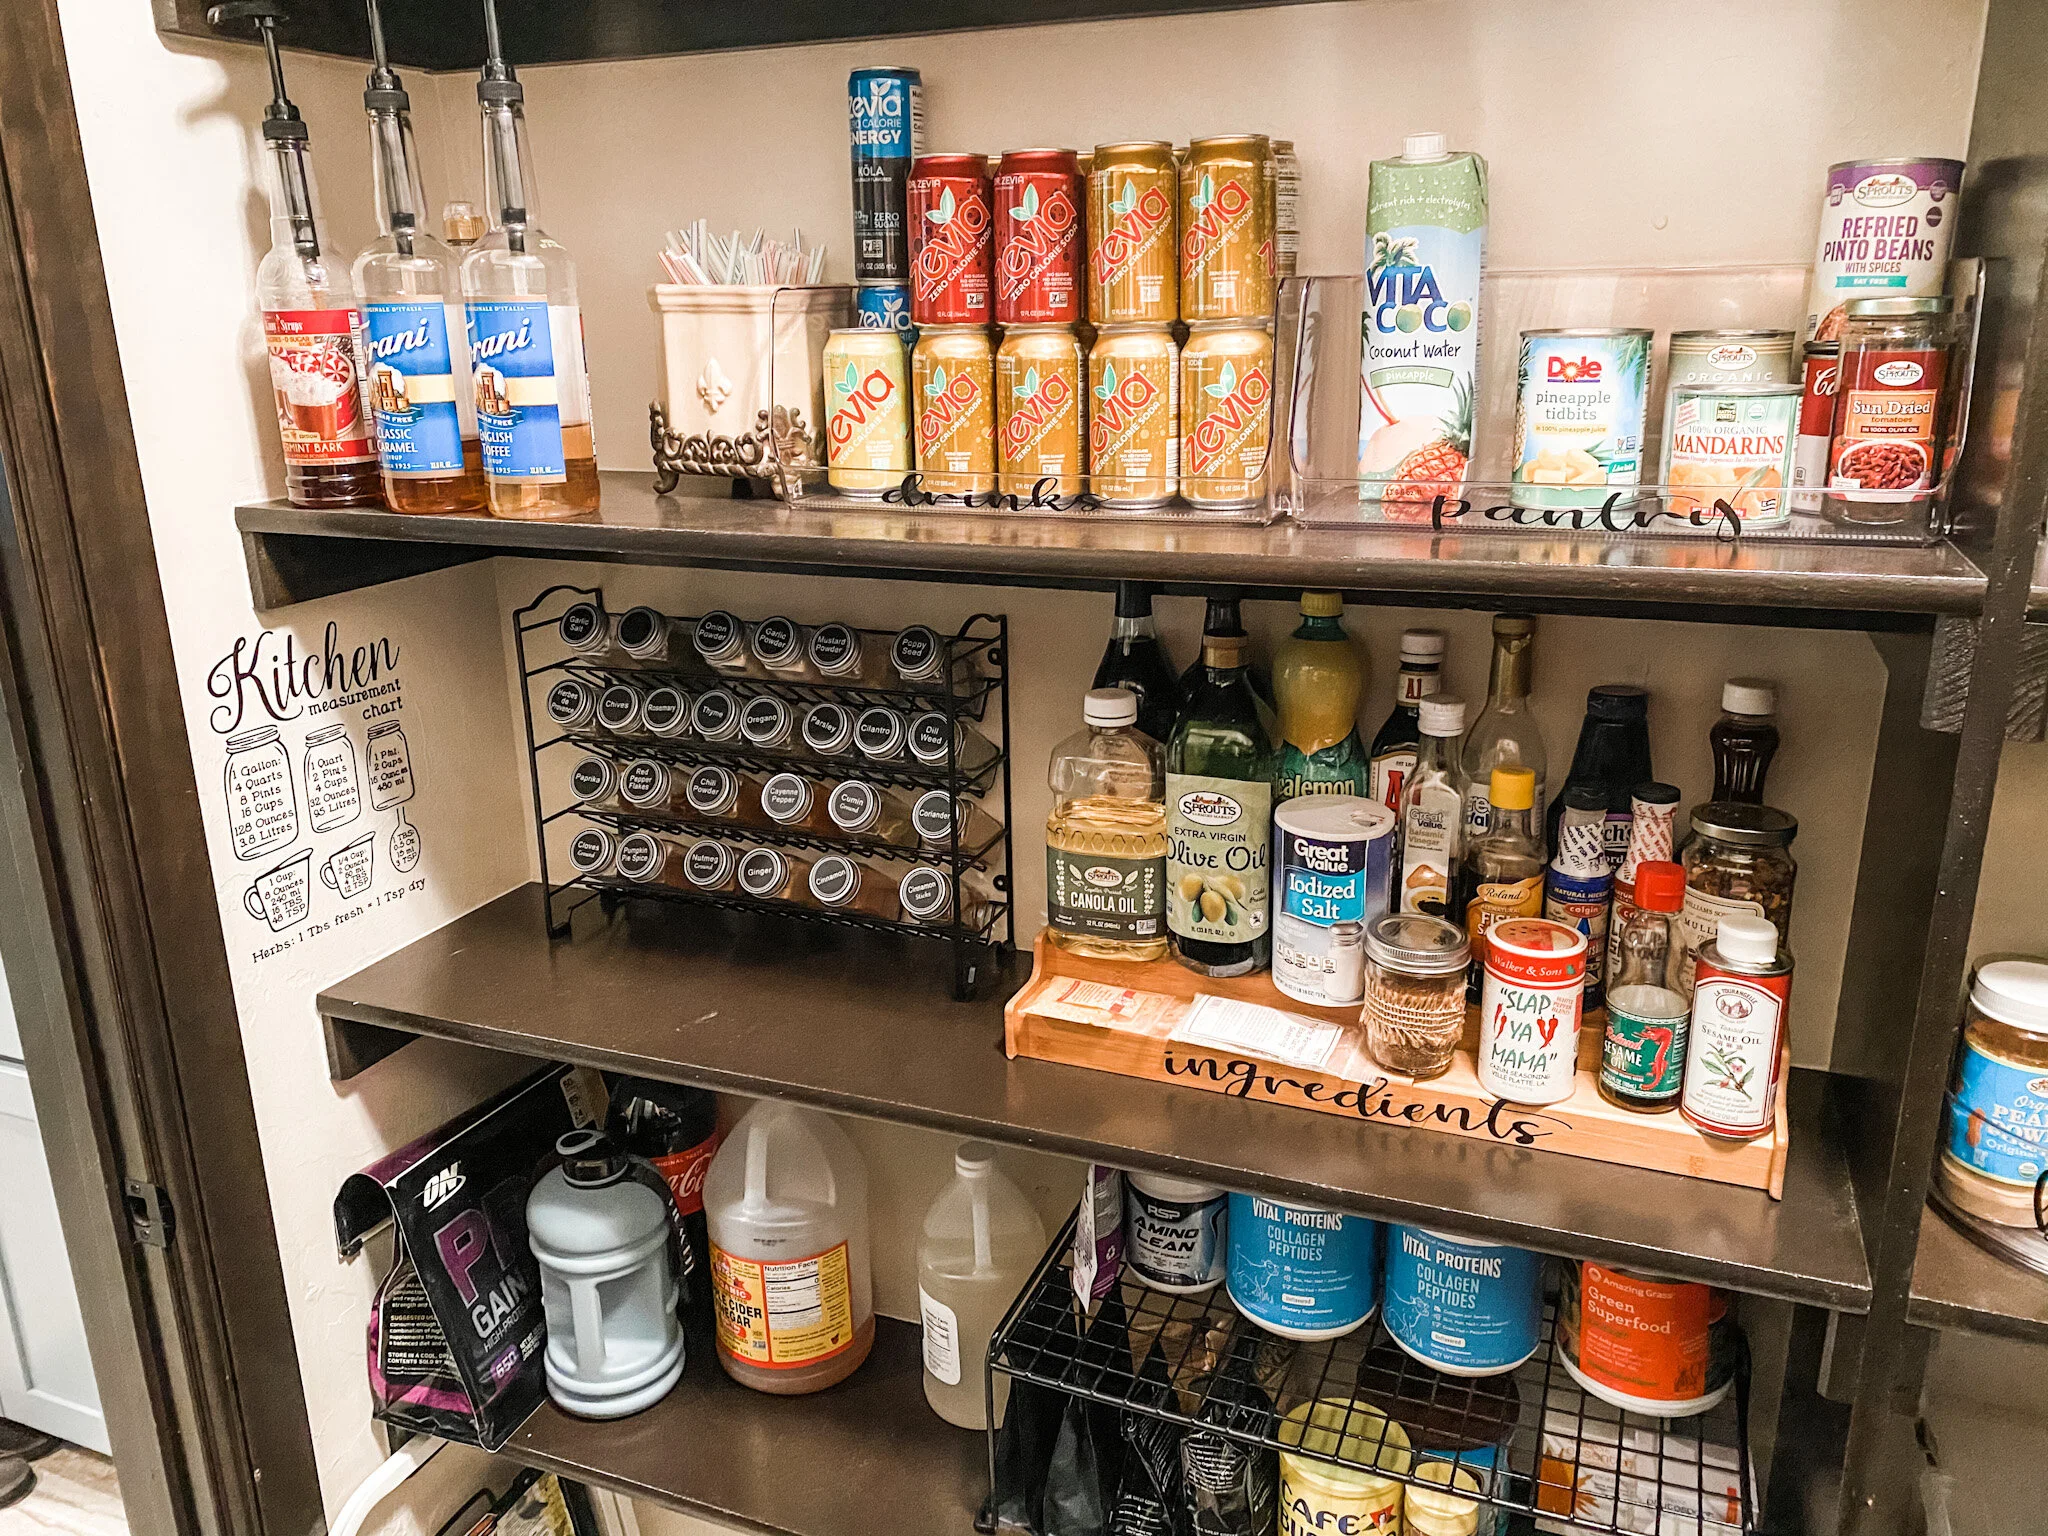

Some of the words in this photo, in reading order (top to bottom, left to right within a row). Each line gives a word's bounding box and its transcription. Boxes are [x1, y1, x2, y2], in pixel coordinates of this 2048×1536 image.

[862, 119, 902, 128] CALORIE
[1857, 185, 1913, 199] SPROUTS
[1425, 196, 1471, 211] electrolytes
[873, 212, 900, 222] ZERO
[873, 221, 900, 229] SUGAR
[1841, 216, 1918, 239] REFRIED
[1823, 240, 1869, 262] PINTO
[1874, 238, 1934, 261] BEANS
[928, 279, 949, 302] ZERO
[947, 248, 979, 281] CALORIE
[977, 226, 992, 250] SODA
[1845, 262, 1866, 273] WITH
[1868, 261, 1901, 273] SPICES
[1366, 265, 1443, 306] VITA
[1376, 300, 1473, 333] COCO
[1710, 353, 1754, 364] SPROUTS
[1547, 355, 1602, 379] Dole
[1878, 369, 1920, 380] SPROUTS
[1385, 369, 1435, 382] pineapple
[1687, 371, 1773, 382] ORGANIC
[1536, 391, 1611, 407] pineapple
[1545, 407, 1597, 420] tidbits
[1852, 400, 1883, 415] Sun
[1886, 400, 1931, 415] Dried
[376, 426, 412, 440] CLASSIC
[1713, 425, 1768, 435] ORGANIC
[313, 442, 344, 453] BARK
[376, 440, 418, 453] CARAMEL
[482, 443, 512, 457] TOFFEE
[1673, 434, 1784, 454] MANDARINS
[881, 474, 1113, 512] drinks
[1432, 487, 1743, 542] pantry
[569, 615, 589, 626] Garlic
[569, 623, 584, 633] Salt
[705, 621, 728, 632] Onion
[699, 629, 726, 641] Powder
[765, 627, 787, 640] Garlic
[758, 634, 787, 649] Powder
[207, 621, 400, 734] Kitchen
[308, 678, 401, 716] measurement
[605, 699, 629, 709] Chives
[362, 696, 403, 720] chart
[647, 704, 676, 713] Rosemary
[702, 705, 724, 719] Thyme
[746, 713, 778, 725] Oregano
[810, 715, 837, 733] Parsley
[860, 723, 891, 735] Cilantro
[925, 725, 939, 735] Dill
[920, 733, 943, 745] Weed
[317, 754, 343, 769] Quart
[313, 772, 319, 783] 2
[322, 765, 347, 779] Pints
[575, 772, 601, 784] Paprika
[629, 774, 653, 784] Pepper
[635, 767, 650, 776] Red
[235, 783, 242, 793] 4
[245, 771, 283, 790] Quarts
[315, 783, 321, 792] 4
[324, 776, 348, 789] Cups
[628, 781, 650, 791] Flakes
[700, 777, 717, 787] Chili
[240, 796, 247, 806] 8
[252, 785, 281, 802] Pints
[310, 797, 320, 808] 32
[323, 786, 356, 803] Ounces
[692, 784, 720, 796] Powder
[769, 787, 799, 797] Cayenne
[771, 796, 796, 804] Pepper
[241, 807, 252, 819] 16
[254, 798, 284, 813] Cups
[919, 808, 951, 820] Coriander
[1182, 801, 1237, 816] SPROUTS
[1409, 808, 1444, 823] Great
[234, 822, 253, 837] 128
[255, 809, 295, 828] Ounces
[1417, 819, 1443, 830] Value
[1174, 826, 1207, 839] EXTRA
[1209, 831, 1247, 843] VIRGIN
[1166, 835, 1219, 869] Olive
[1226, 843, 1266, 872] Oil
[1293, 838, 1349, 862] Great
[692, 853, 719, 865] Nutmeg
[1305, 857, 1348, 873] Value
[747, 866, 773, 877] Ginger
[815, 869, 846, 886] Cinnamon
[907, 881, 937, 894] Cinnamon
[1289, 872, 1356, 899] Iodized
[1485, 887, 1522, 900] Roland
[1070, 891, 1116, 912] CANOLA
[1118, 897, 1138, 914] OIL
[1301, 899, 1340, 920] Salt
[1569, 905, 1600, 915] colgin
[252, 938, 295, 963] Herbs:
[307, 922, 331, 938] Tbs
[334, 906, 364, 926] fresh
[383, 887, 405, 902] Tsp
[408, 878, 426, 891] dry
[1493, 954, 1524, 973] Walker
[1525, 965, 1537, 977] &
[1539, 967, 1563, 977] Sons
[1510, 1020, 1532, 1043] YA
[1604, 1040, 1642, 1067] SESAME
[1610, 1056, 1627, 1072] OIL
[1164, 1049, 1572, 1145] ingredients
[1147, 1204, 1180, 1220] RSP
[1252, 1197, 1281, 1222] VITAL
[1284, 1211, 1343, 1231] PROTEINS
[1134, 1216, 1200, 1239] AMINO
[1136, 1228, 1196, 1252] LEAN
[1267, 1224, 1325, 1247] COLLAGEN
[1268, 1240, 1322, 1261] PEPTIDES
[1402, 1231, 1431, 1262] VITAL
[1435, 1250, 1502, 1279] PROTEINS
[764, 1264, 797, 1272] Nutrition
[798, 1259, 818, 1269] Facts
[1416, 1263, 1480, 1294] COLLAGEN
[1417, 1280, 1476, 1310] PEPTIDES
[1602, 1277, 1645, 1298] Amazing
[1645, 1289, 1673, 1300] Grass
[471, 1269, 529, 1340] GAIN
[1588, 1286, 1635, 1314] Green
[729, 1299, 763, 1319] CIDER
[1588, 1300, 1671, 1335] Superfood
